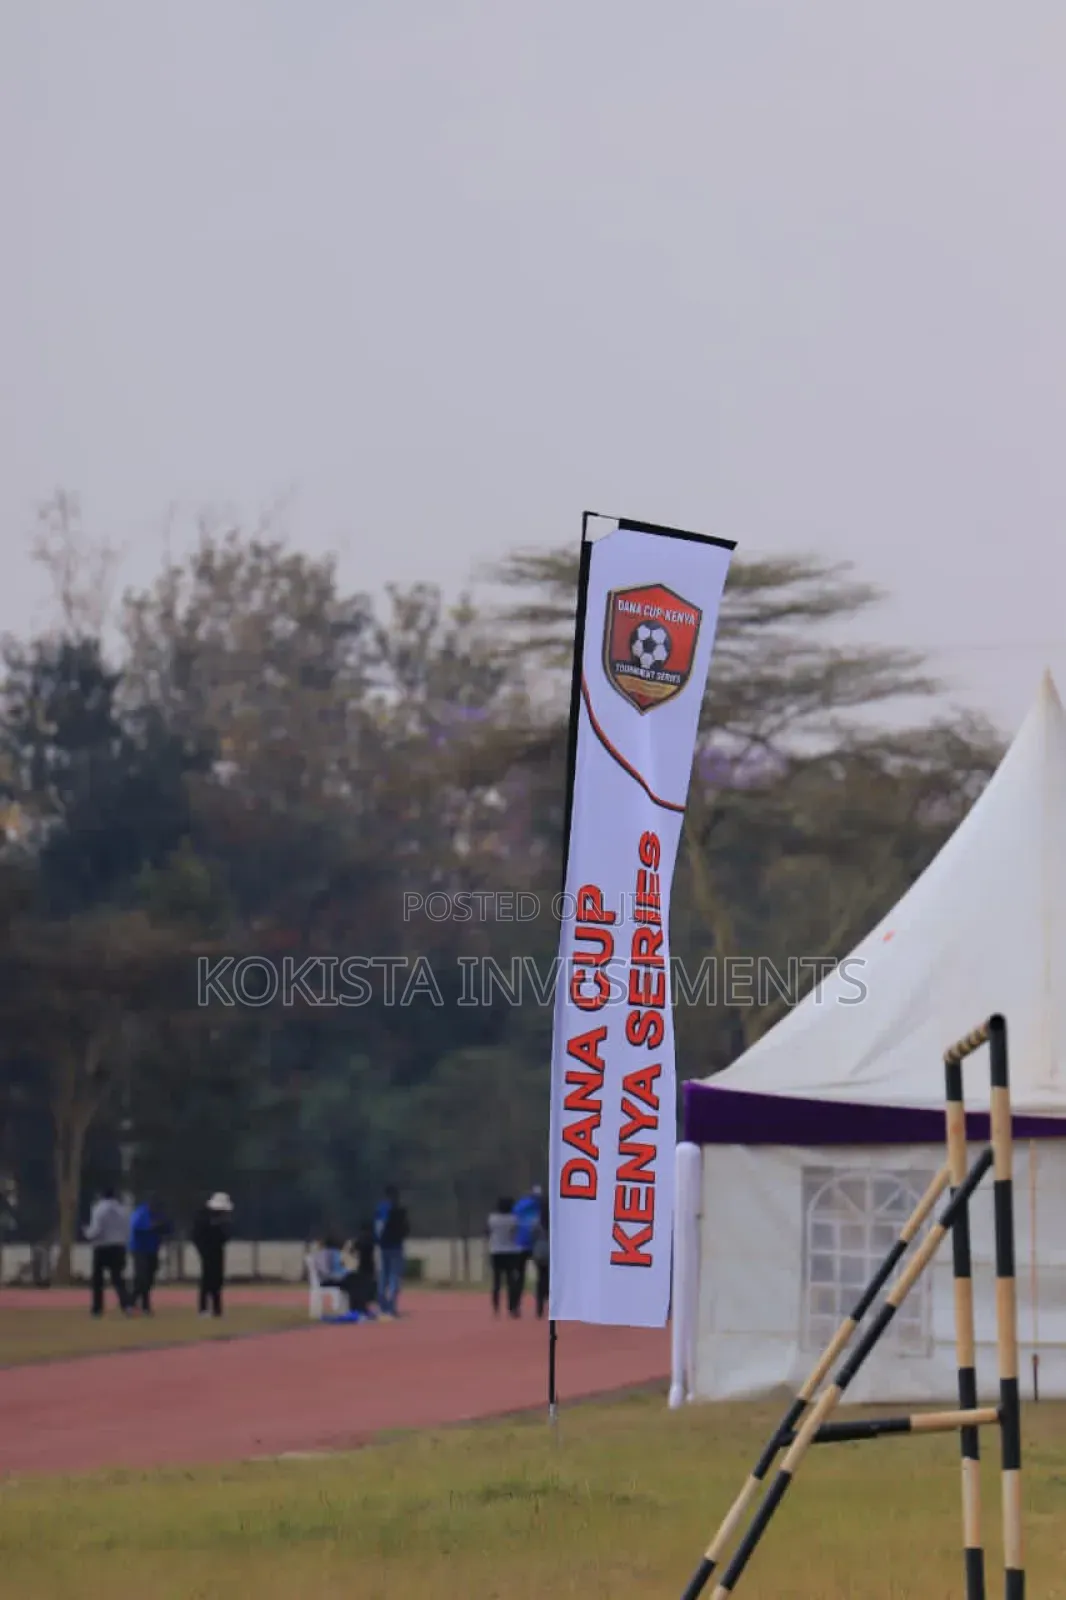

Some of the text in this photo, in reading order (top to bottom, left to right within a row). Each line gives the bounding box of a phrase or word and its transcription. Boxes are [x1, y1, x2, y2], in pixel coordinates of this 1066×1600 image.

[618, 599, 642, 614] DANA
[560, 884, 617, 1200] DANA CUP
[610, 830, 666, 1267] KENYA SERIES
